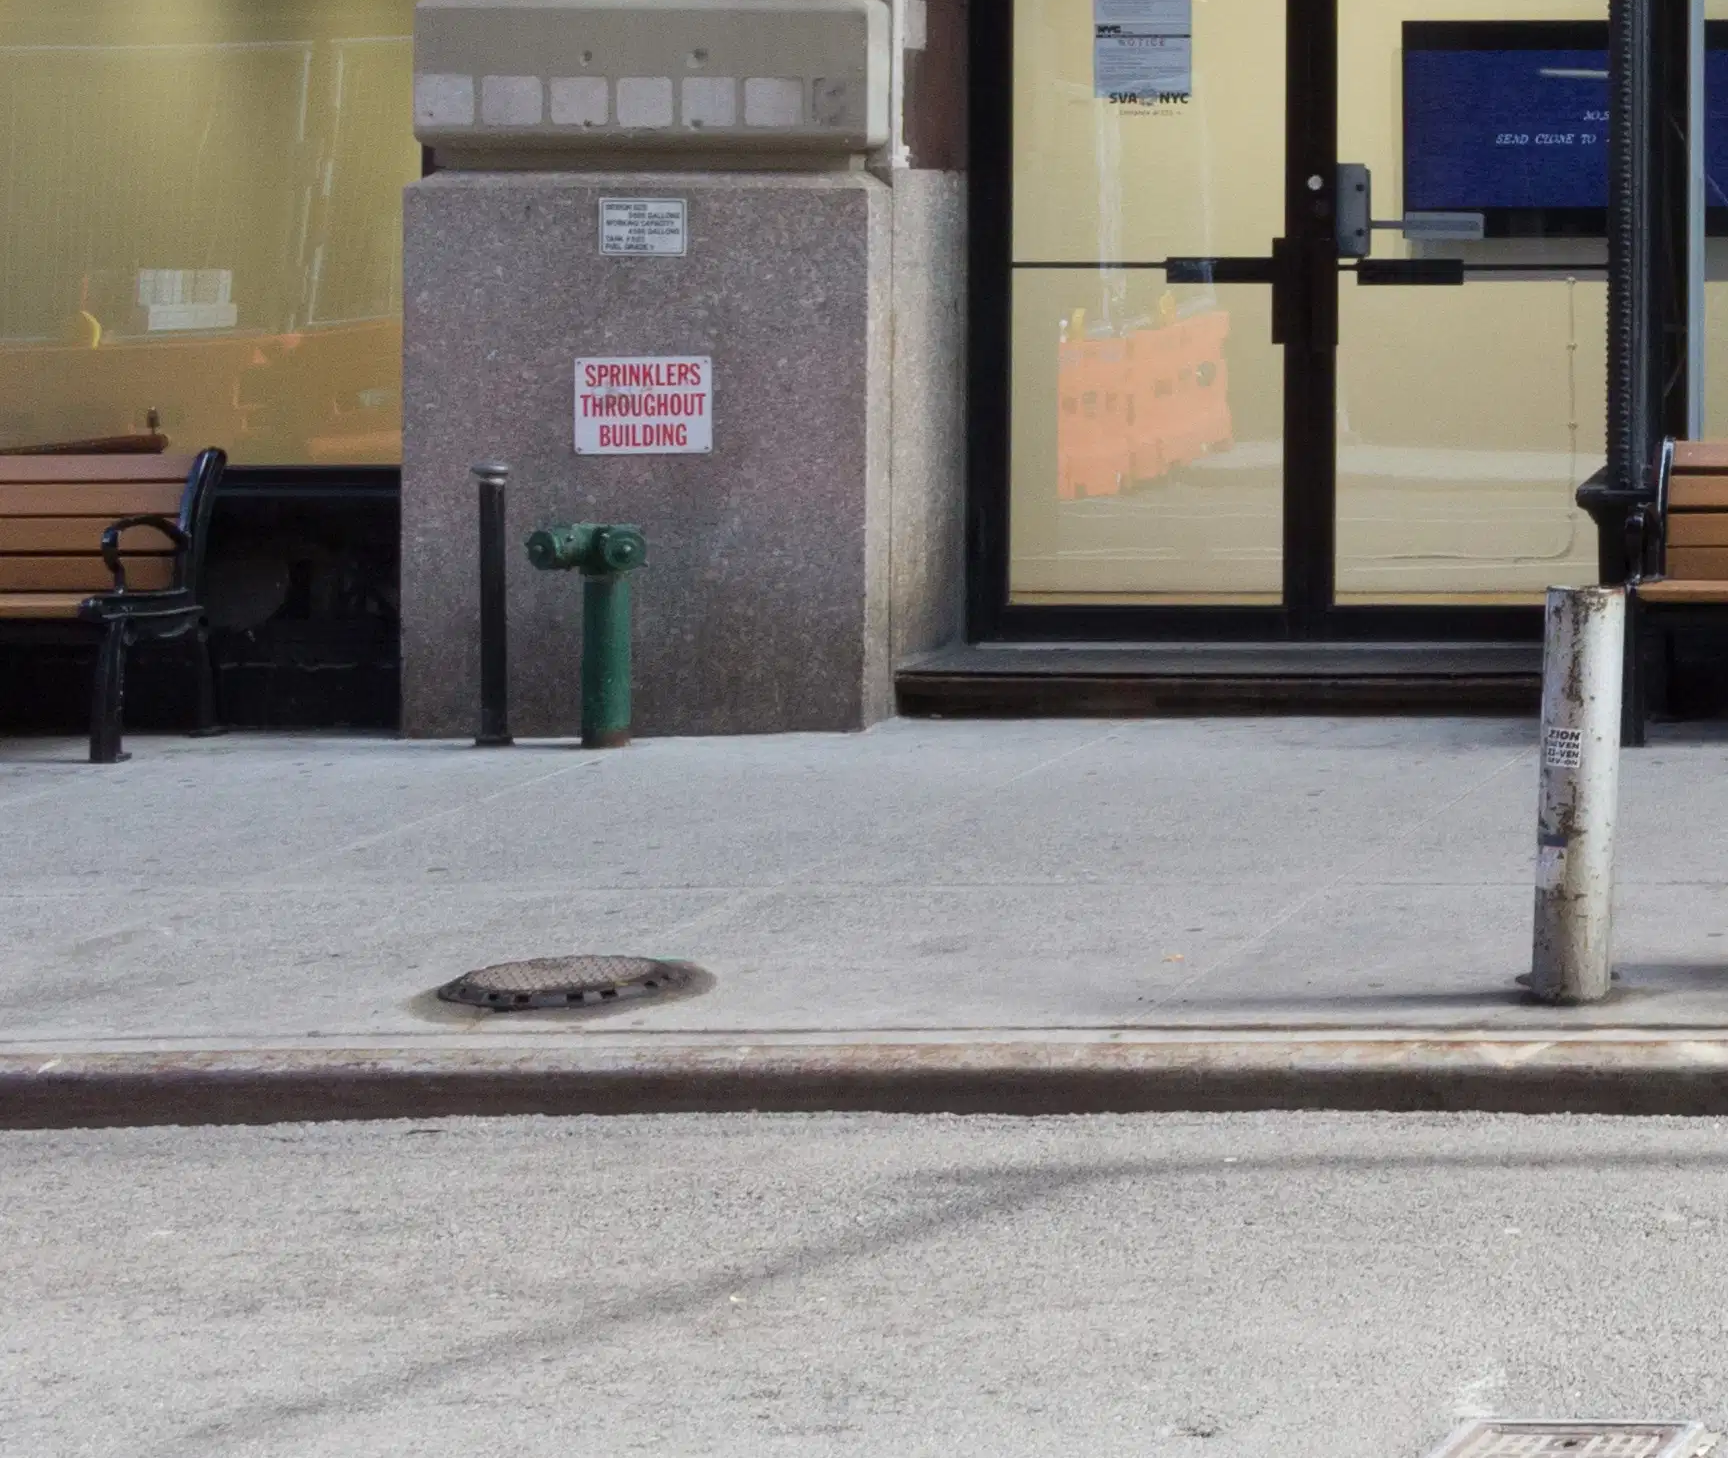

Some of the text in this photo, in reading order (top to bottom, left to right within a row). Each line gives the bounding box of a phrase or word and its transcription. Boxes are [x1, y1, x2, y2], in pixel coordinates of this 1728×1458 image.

[1109, 92, 1138, 104] SVA
[1159, 92, 1189, 104] NYC
[585, 363, 701, 387] SPRINKLERS
[580, 393, 706, 417] THROUGHOUT
[600, 423, 687, 447] BUILDING
[1549, 729, 1581, 741] ZION
